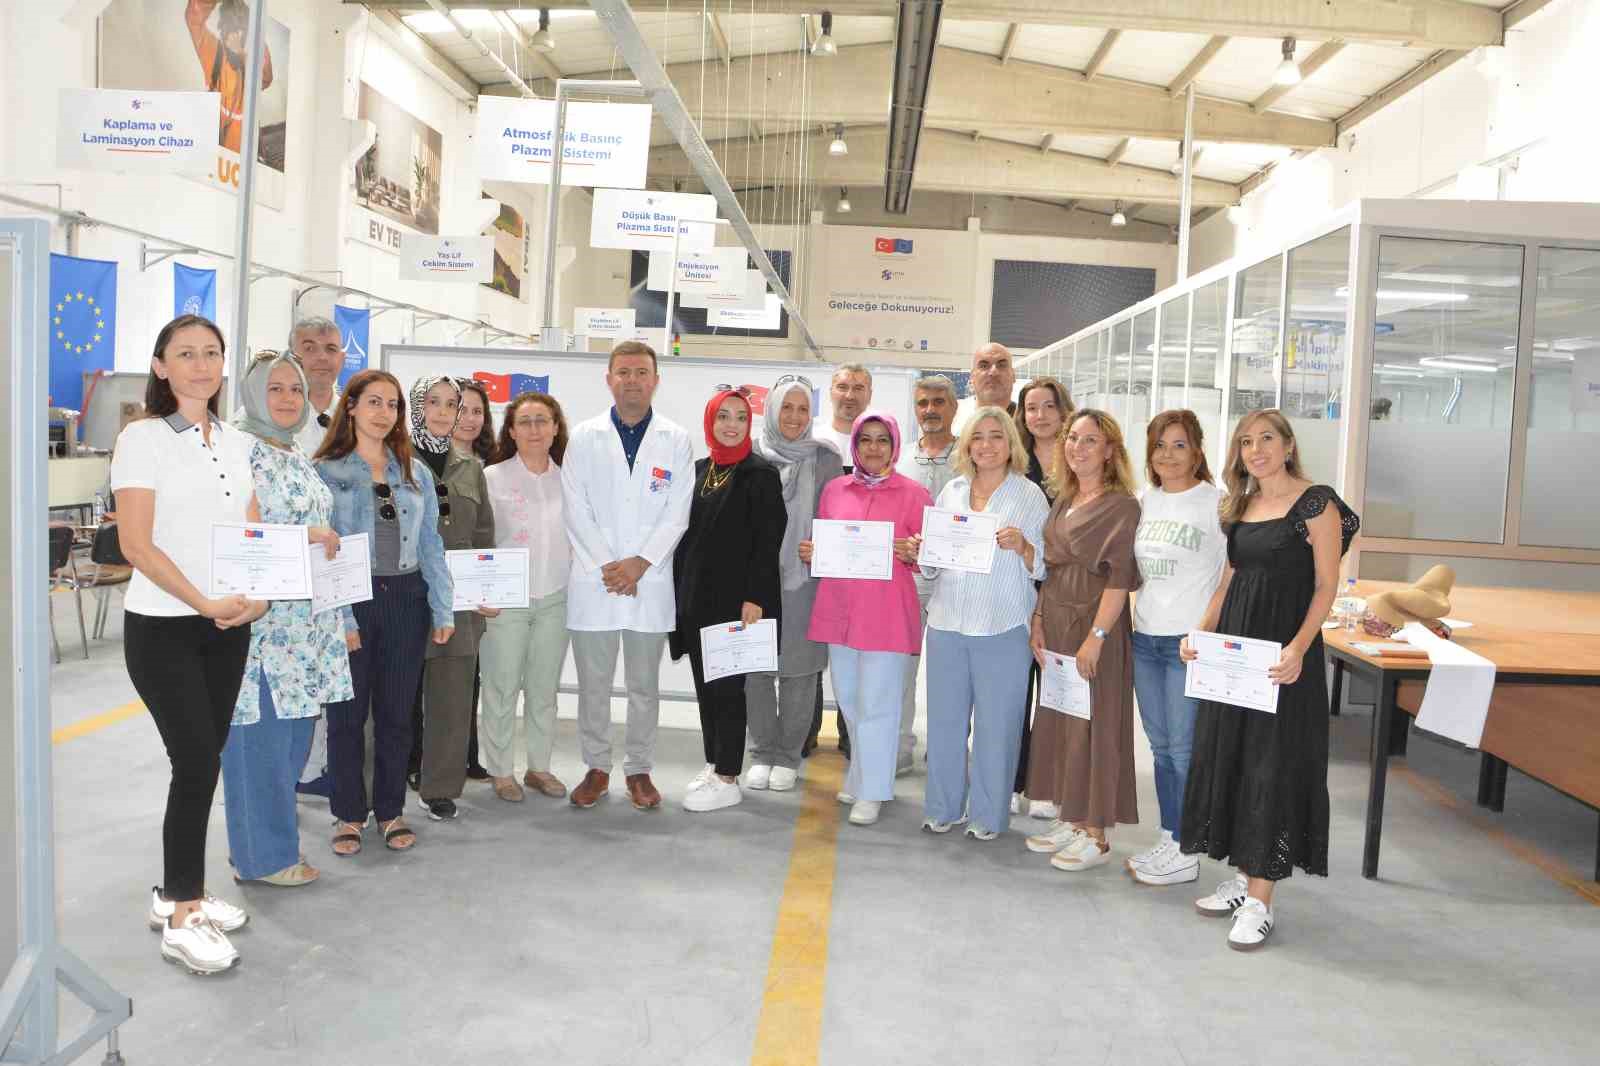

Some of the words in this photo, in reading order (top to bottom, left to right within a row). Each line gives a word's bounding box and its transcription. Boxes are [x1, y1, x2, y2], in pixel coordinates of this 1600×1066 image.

[103, 118, 156, 131] Kaplama
[159, 121, 173, 131] ve
[83, 133, 155, 147] Laminasyon
[159, 135, 194, 147] Cihazı
[503, 127, 576, 142] Atmosfik
[580, 132, 623, 146] Basınç
[511, 143, 556, 157] Plazm
[564, 147, 611, 160] Sistemi
[622, 210, 651, 221] Düşük
[369, 219, 384, 241] EV
[386, 226, 401, 248] TE
[617, 222, 650, 231] Plazma
[828, 300, 878, 312] Geleceğe
[881, 302, 955, 314] Dokunuyoruz!
[1137, 520, 1207, 552] CHIGAN
